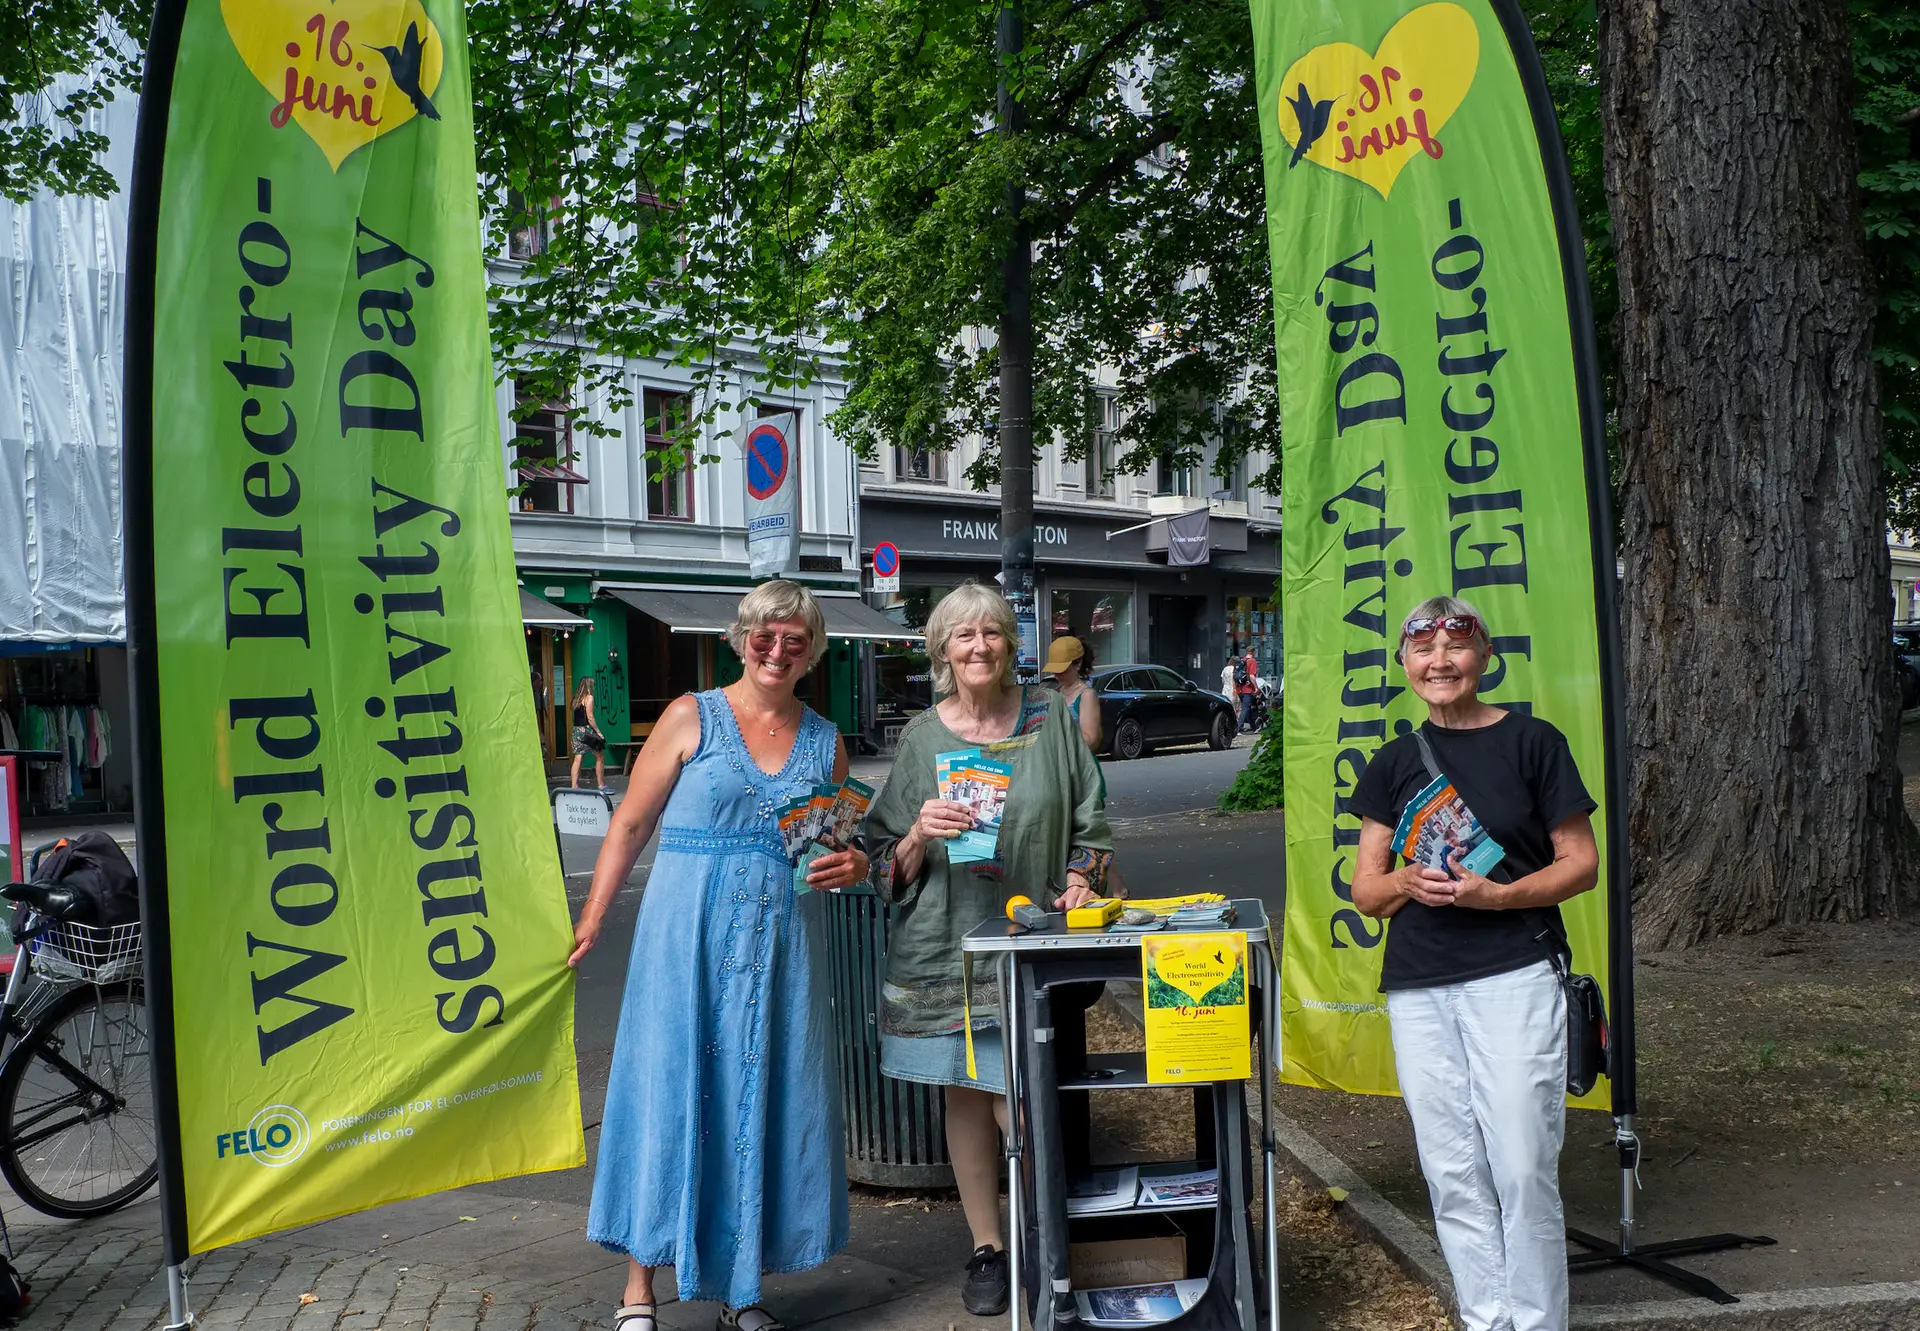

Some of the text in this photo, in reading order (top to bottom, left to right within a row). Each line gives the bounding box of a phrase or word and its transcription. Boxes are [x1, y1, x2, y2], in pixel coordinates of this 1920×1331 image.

[305, 13, 366, 73] 16.
[270, 42, 384, 129] juni
[943, 519, 999, 541] FRANK
[221, 177, 355, 1067] World Electro-
[338, 217, 505, 1034] sensitivity Day
[565, 803, 579, 813] Takk
[580, 805, 589, 814] for
[568, 816, 577, 824] du
[1166, 970, 1224, 979] Electrosensitivity
[1189, 980, 1203, 988] Day
[1175, 1005, 1216, 1020] 16. juni
[321, 1069, 543, 1133] FORENINGEN FOR EL-OVERFØLSOMME
[217, 1123, 292, 1158] FELO
[324, 1124, 415, 1152] www.felo.no
